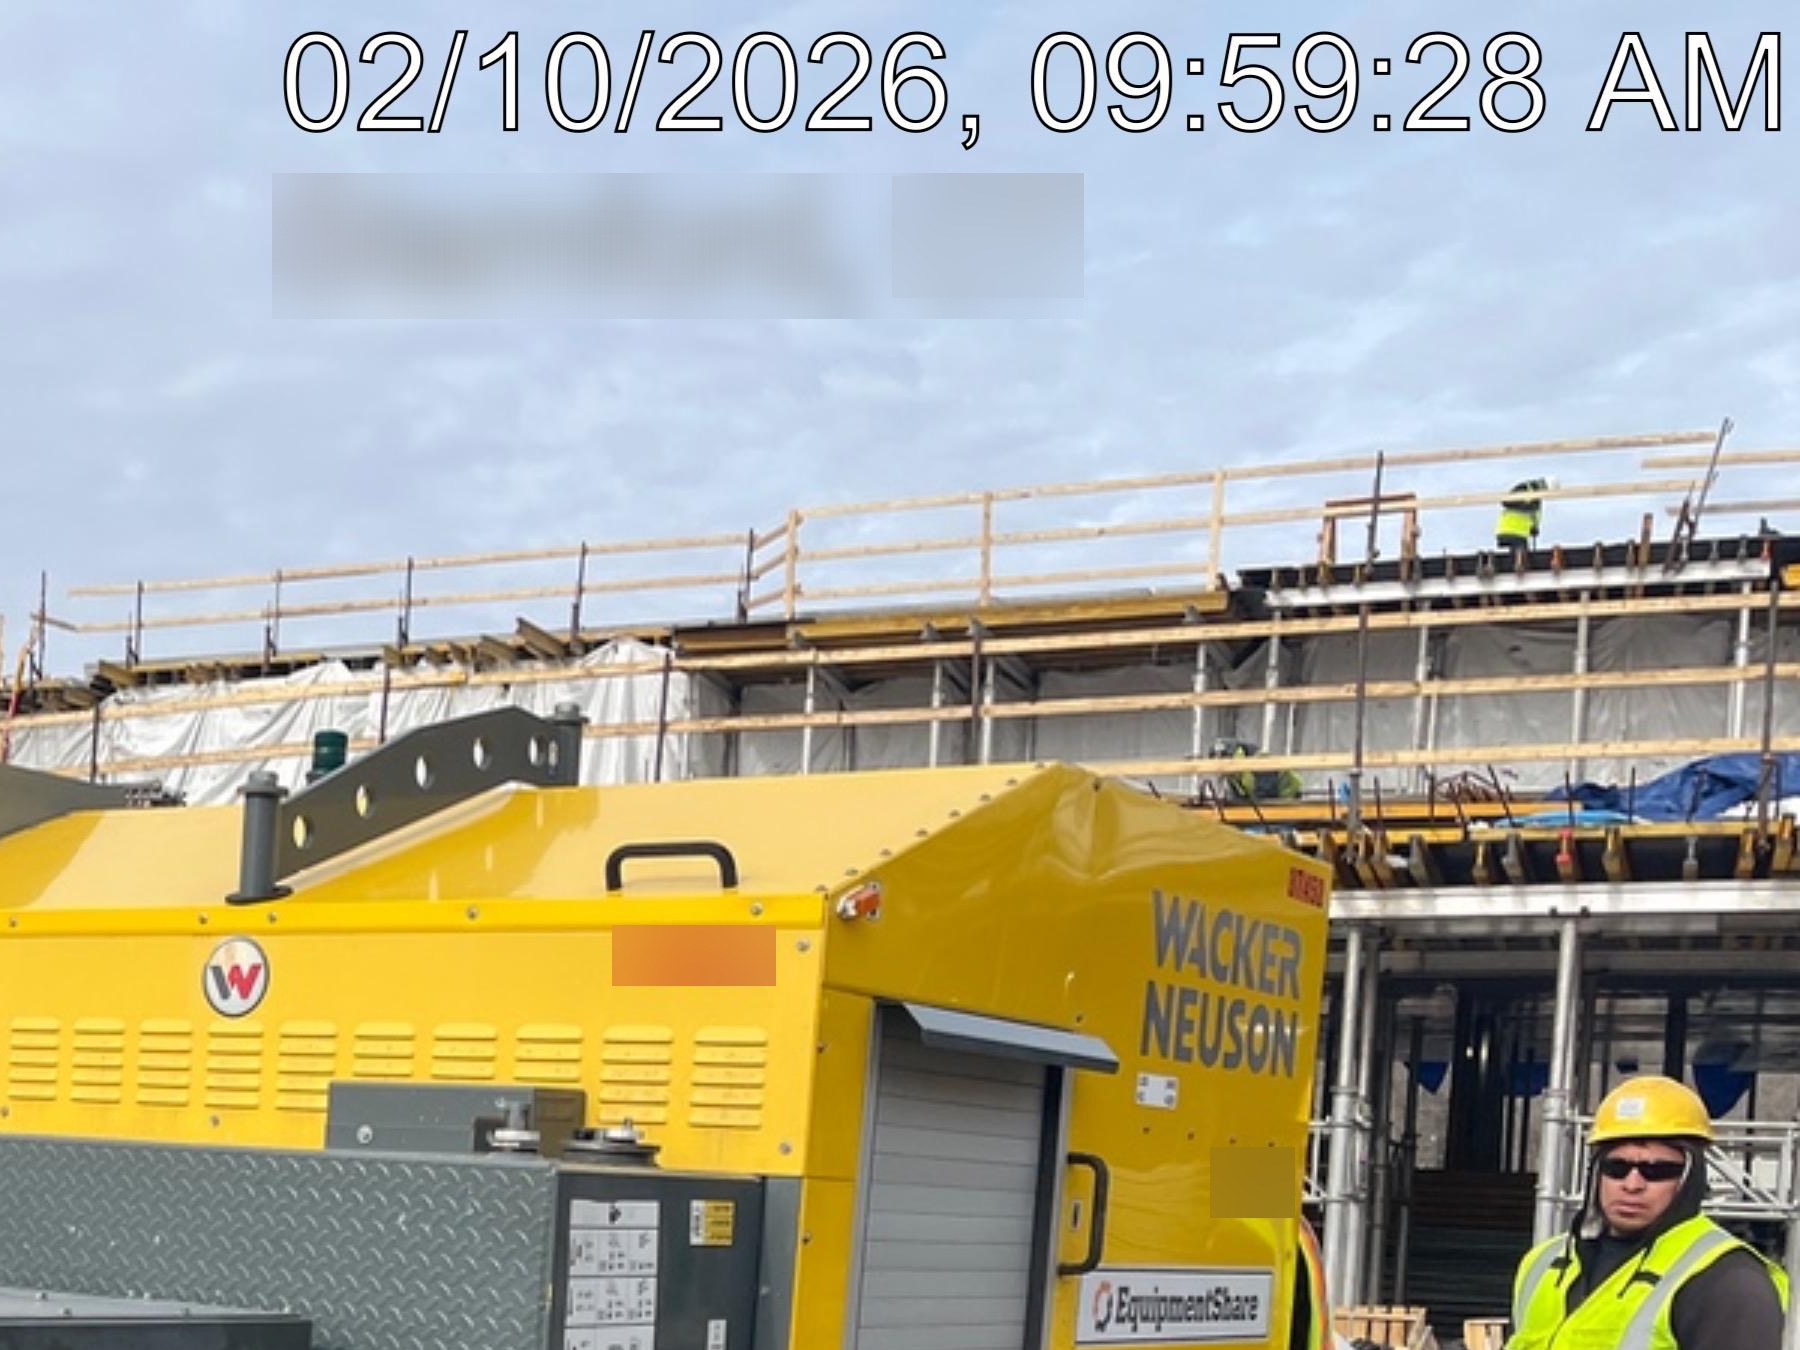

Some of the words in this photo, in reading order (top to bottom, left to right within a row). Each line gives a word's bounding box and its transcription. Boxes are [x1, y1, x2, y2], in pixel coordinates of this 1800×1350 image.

[1152, 888, 1303, 1000] WACKER
[1140, 980, 1299, 1078] NEUSON
[1114, 1284, 1259, 1333] EquipmentShare
